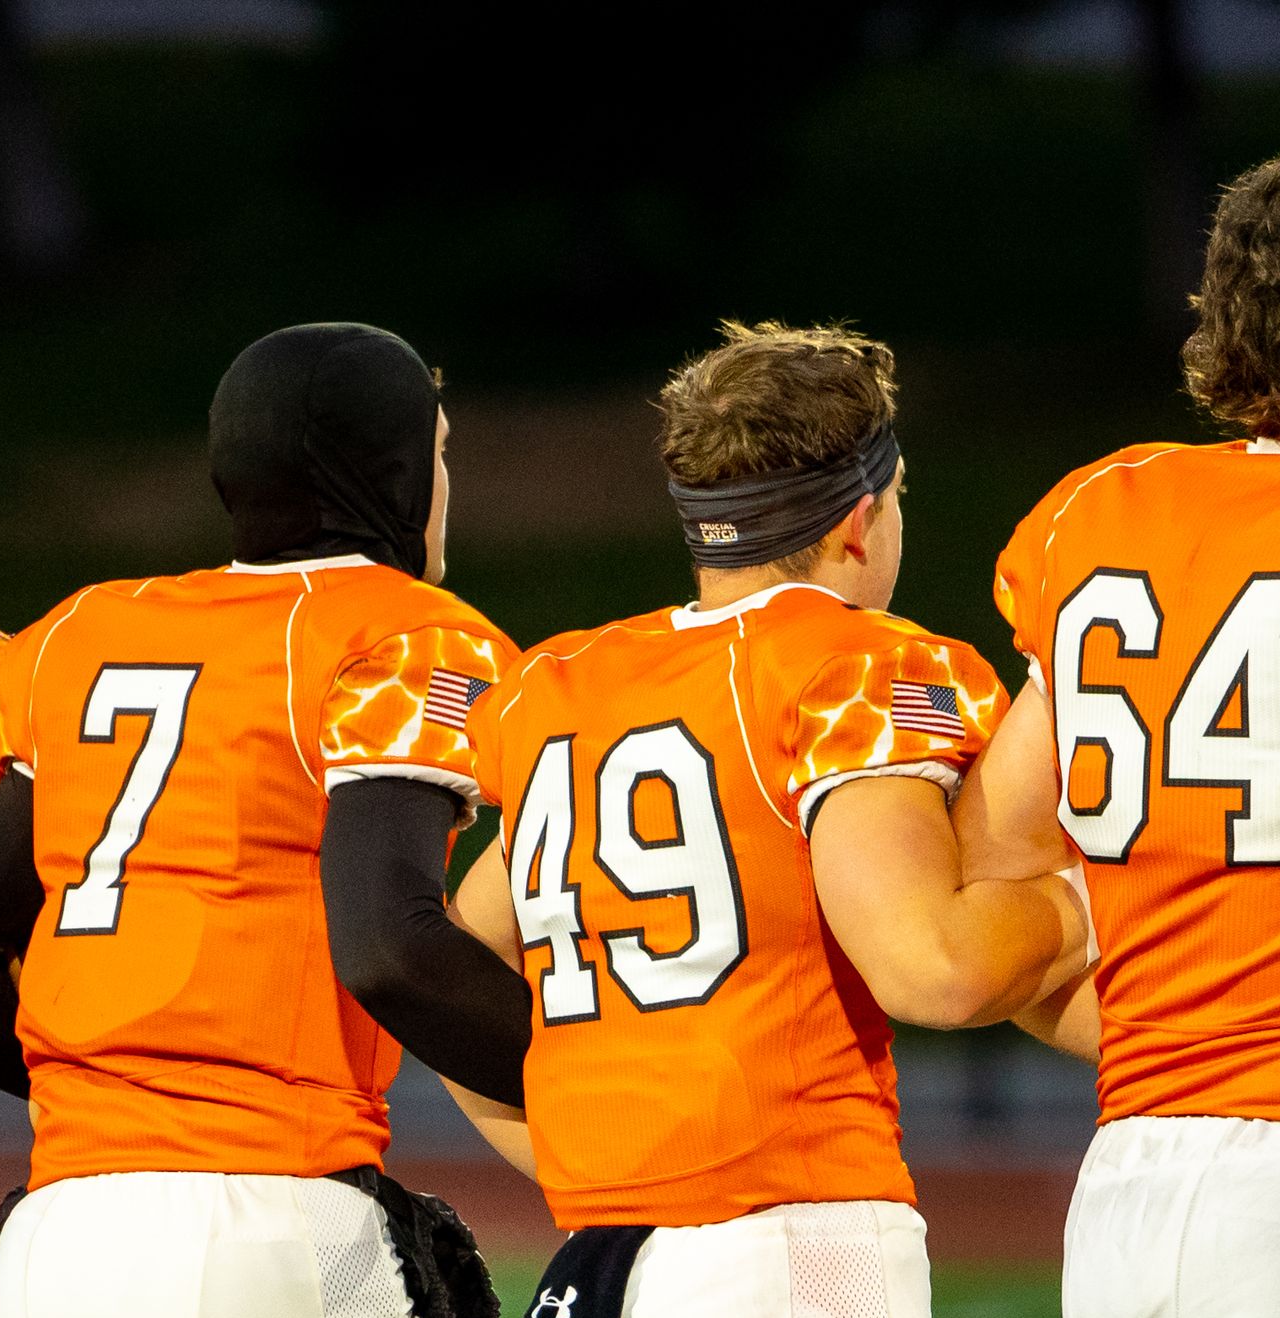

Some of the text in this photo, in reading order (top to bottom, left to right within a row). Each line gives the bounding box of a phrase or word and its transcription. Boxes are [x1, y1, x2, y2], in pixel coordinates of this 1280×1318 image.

[699, 522, 736, 531] CRUCIAL
[701, 530, 738, 540] CATCH
[54, 662, 205, 937] 7
[507, 717, 749, 1028] 49
